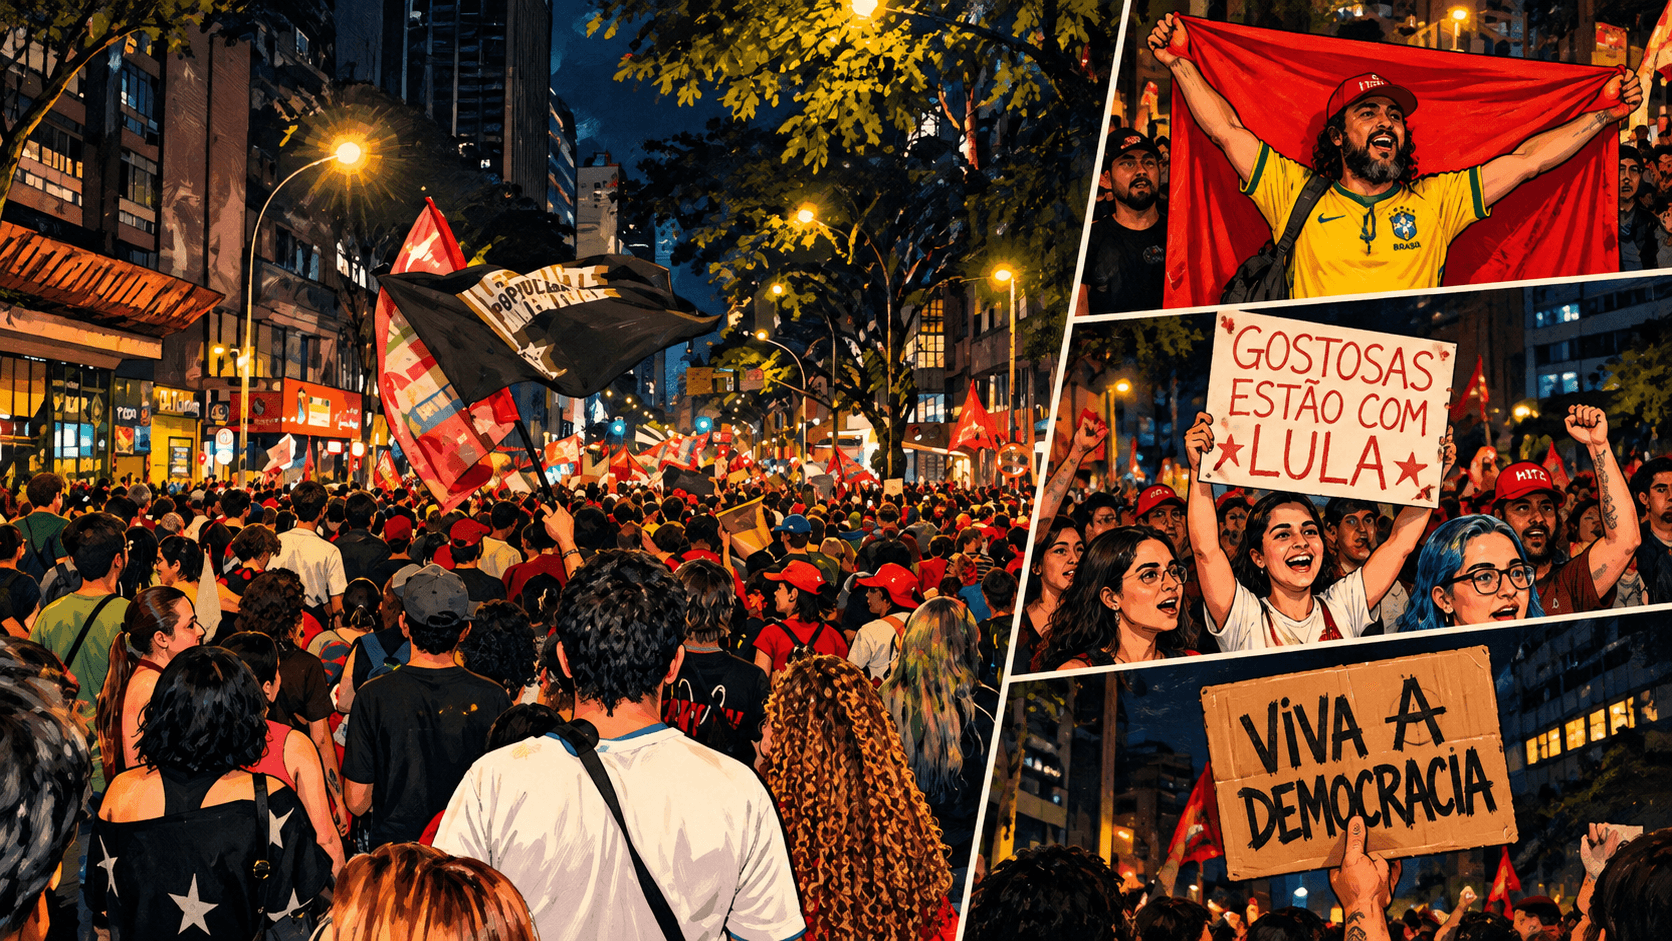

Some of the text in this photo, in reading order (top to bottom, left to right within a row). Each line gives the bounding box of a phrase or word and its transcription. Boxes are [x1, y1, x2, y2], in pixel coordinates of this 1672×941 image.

[1232, 325, 1433, 391] GOSTOSAS
[1229, 378, 1427, 437] ESTÃO COM
[1249, 424, 1386, 490] LULA
[1385, 674, 1446, 752] A
